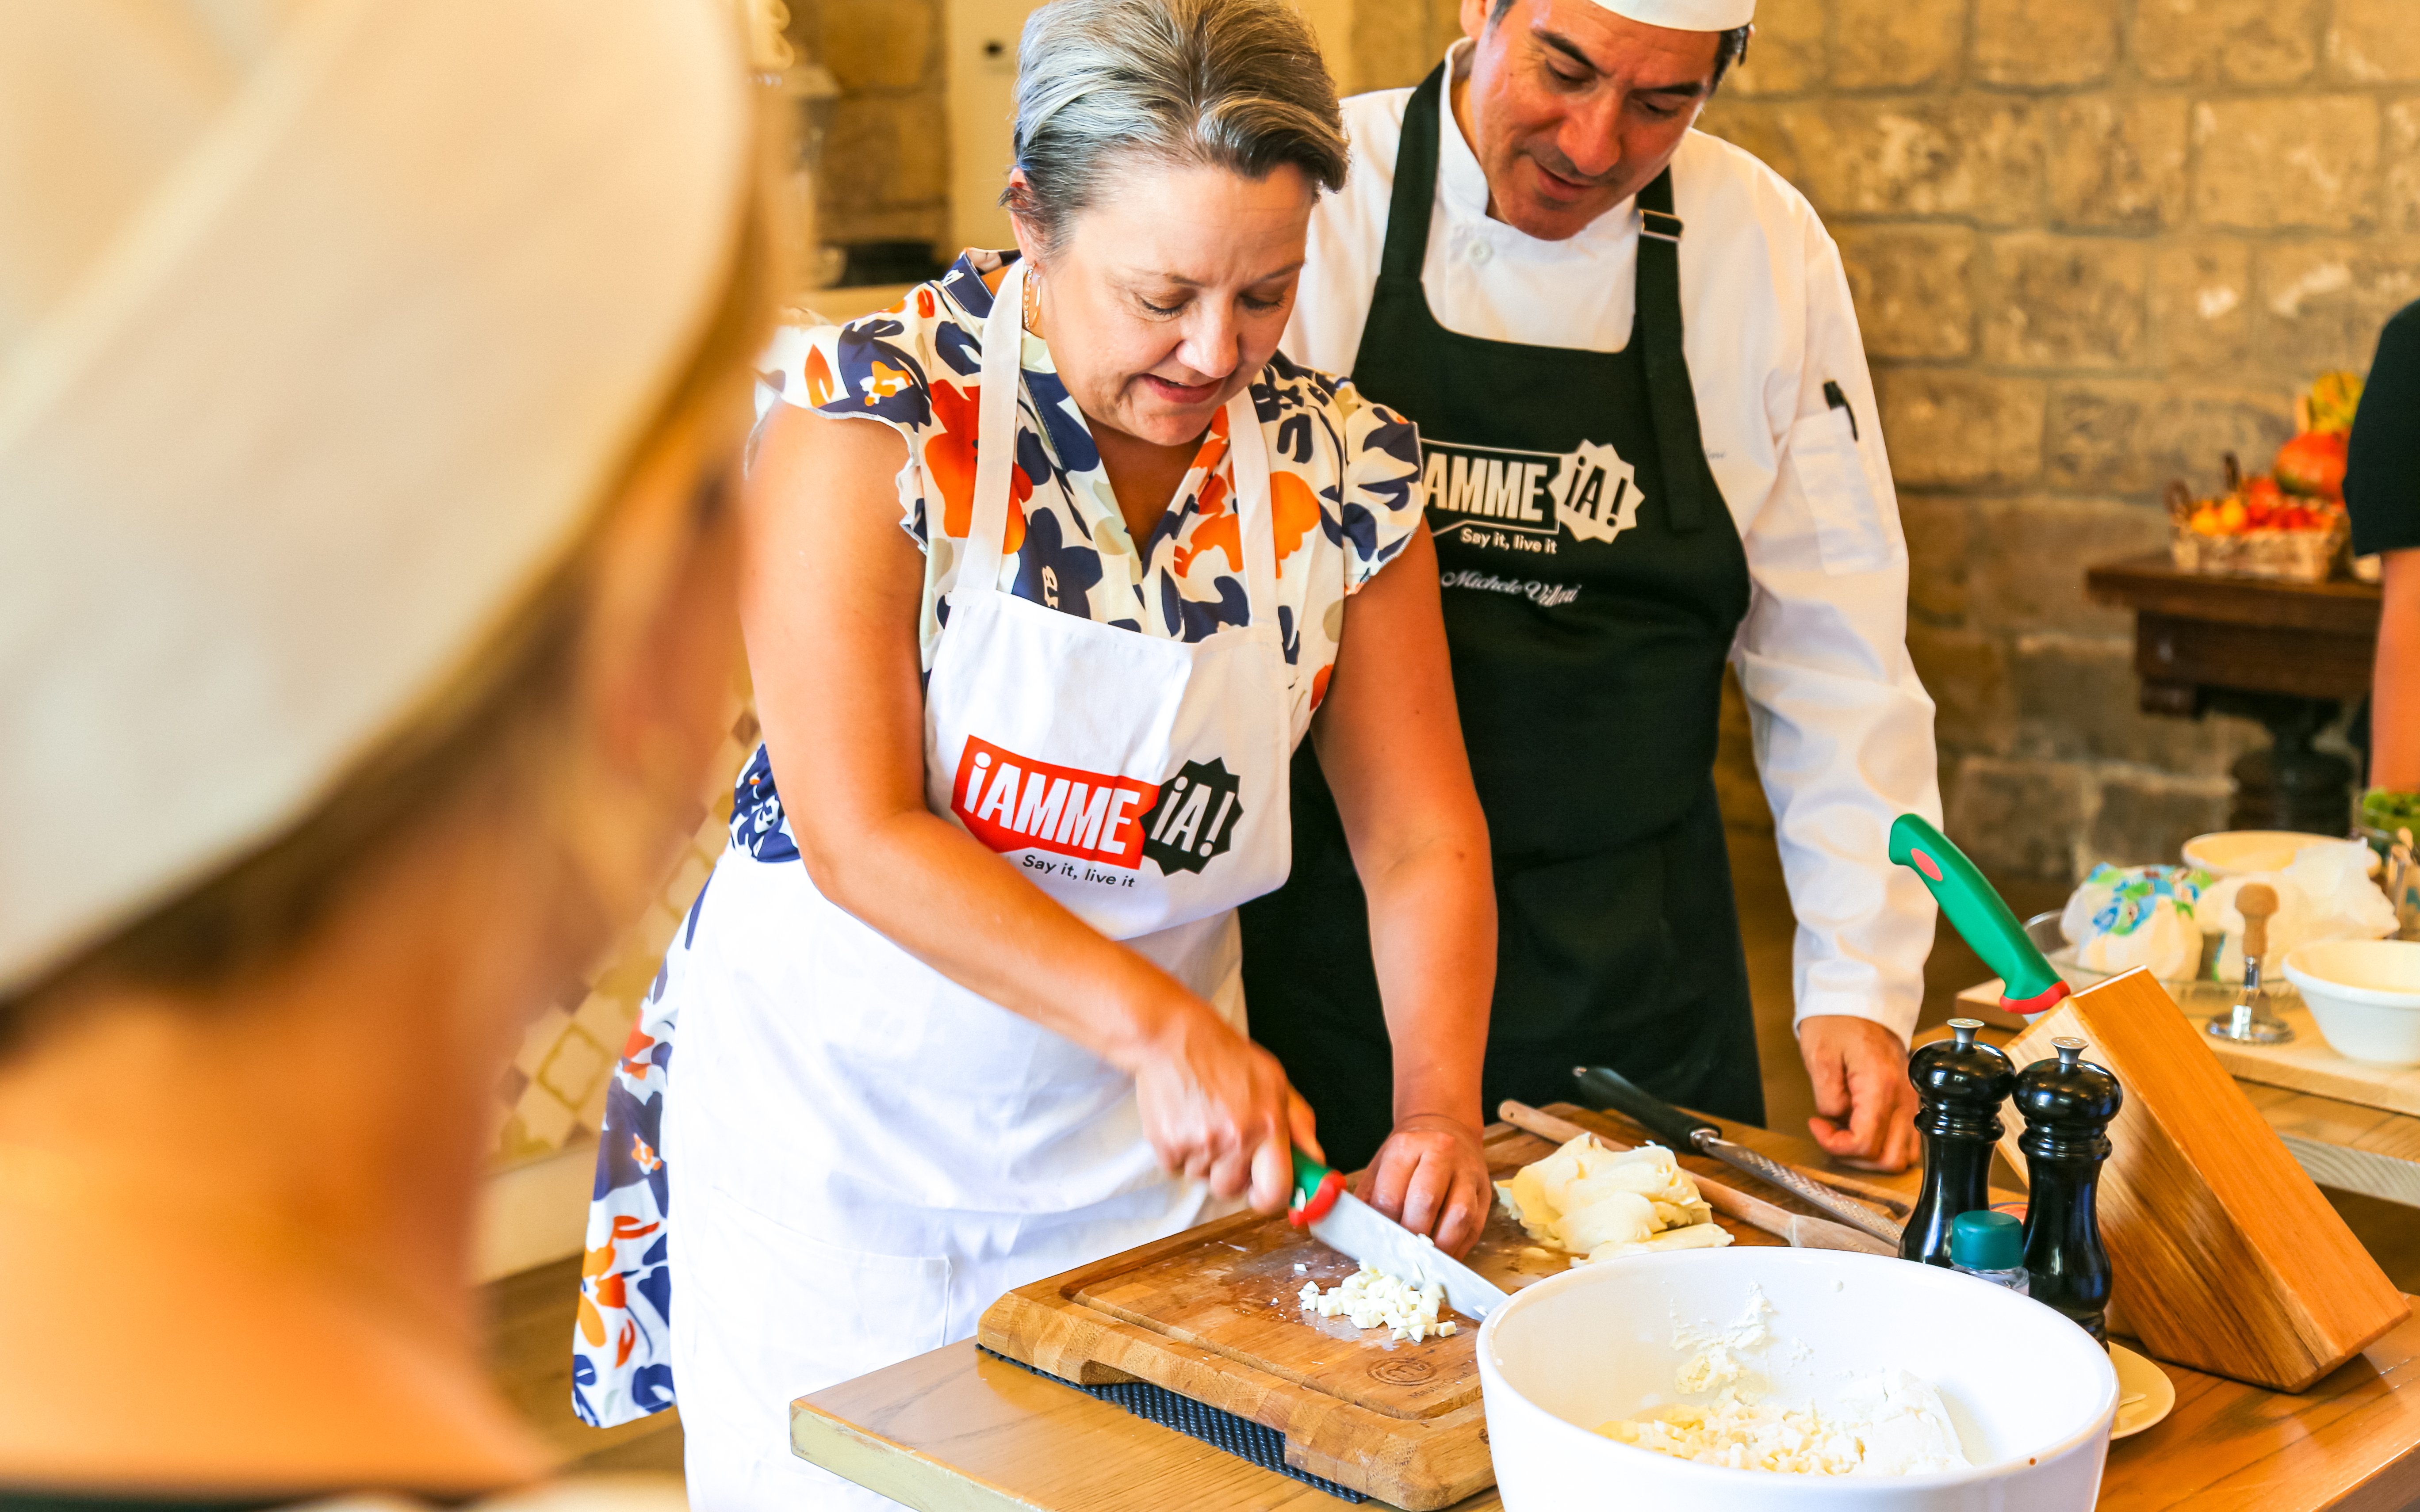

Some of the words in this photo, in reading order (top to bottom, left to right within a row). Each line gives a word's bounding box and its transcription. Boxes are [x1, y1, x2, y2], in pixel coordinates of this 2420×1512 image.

[1423, 452, 1547, 522] AMME
[1460, 527, 1491, 549] Say
[1493, 531, 1510, 551] it,
[1512, 534, 1542, 553] live
[1543, 538, 1558, 554] it
[1022, 854, 1057, 874] Say
[1061, 863, 1078, 880] it,
[1084, 868, 1117, 885] live
[1122, 875, 1135, 887] it
[1407, 1371, 1471, 1399] MasterChef
